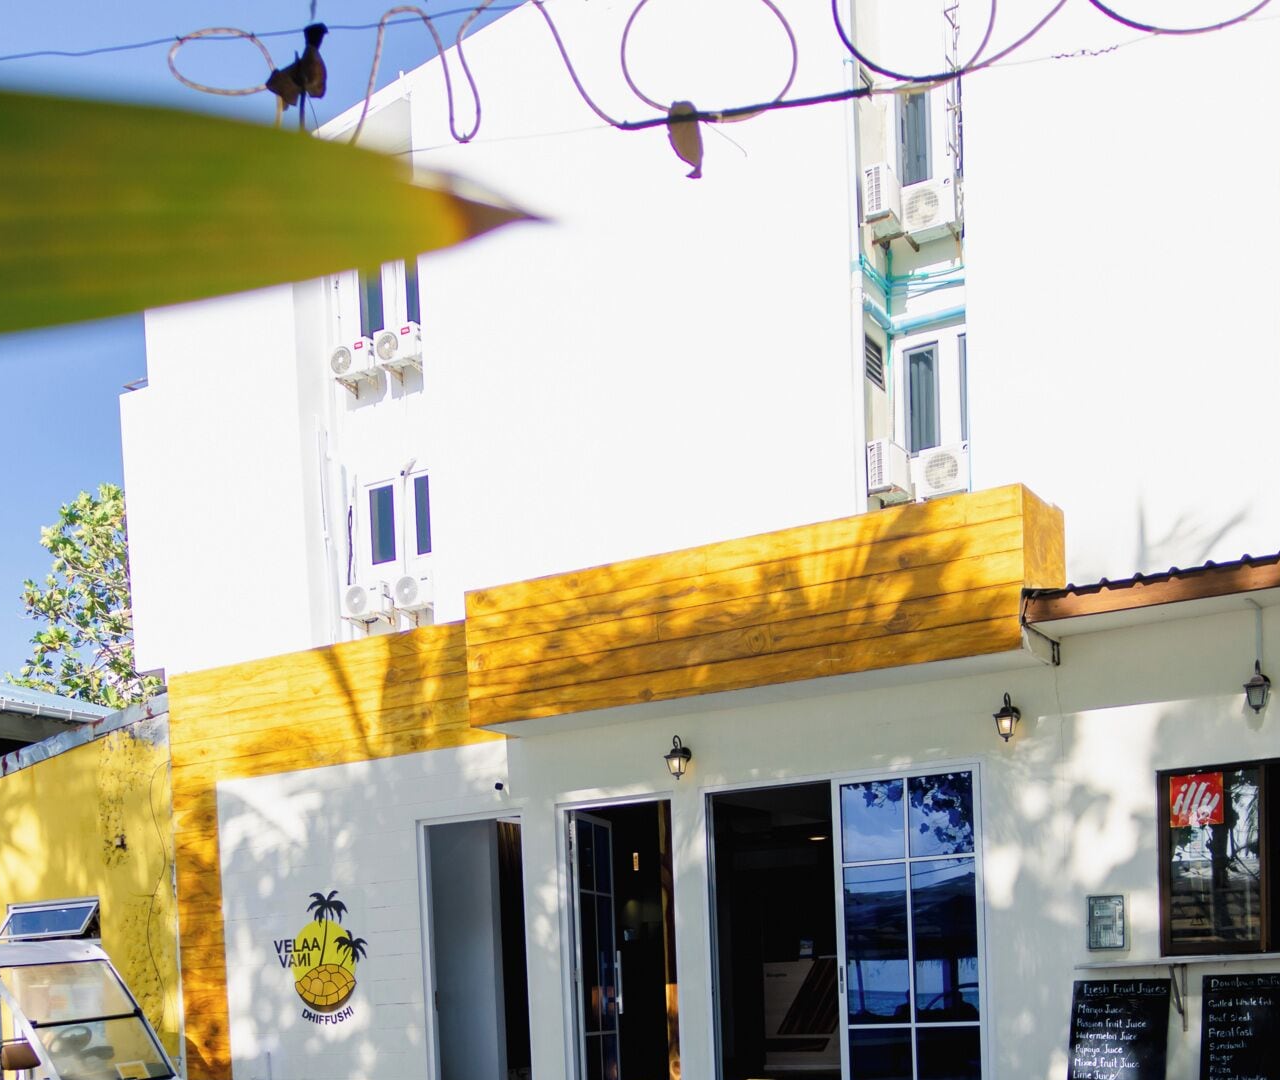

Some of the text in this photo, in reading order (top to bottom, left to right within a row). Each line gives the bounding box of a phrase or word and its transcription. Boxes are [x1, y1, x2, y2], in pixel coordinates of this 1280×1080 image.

[1172, 781, 1220, 818] illy
[274, 937, 321, 954] VELAA
[279, 953, 311, 968] VANI
[1083, 982, 1167, 994] Fresh Fruit Juices
[301, 1005, 355, 1025] DHIFFUSHI
[1077, 1004, 1102, 1016] Mango
[1125, 1018, 1147, 1028] Juice
[1075, 1043, 1123, 1057] Papaya Juice
[1074, 1057, 1097, 1067] Mixed
[1120, 1057, 1140, 1068] Juice
[1072, 1070, 1115, 1080] Lime Juice
